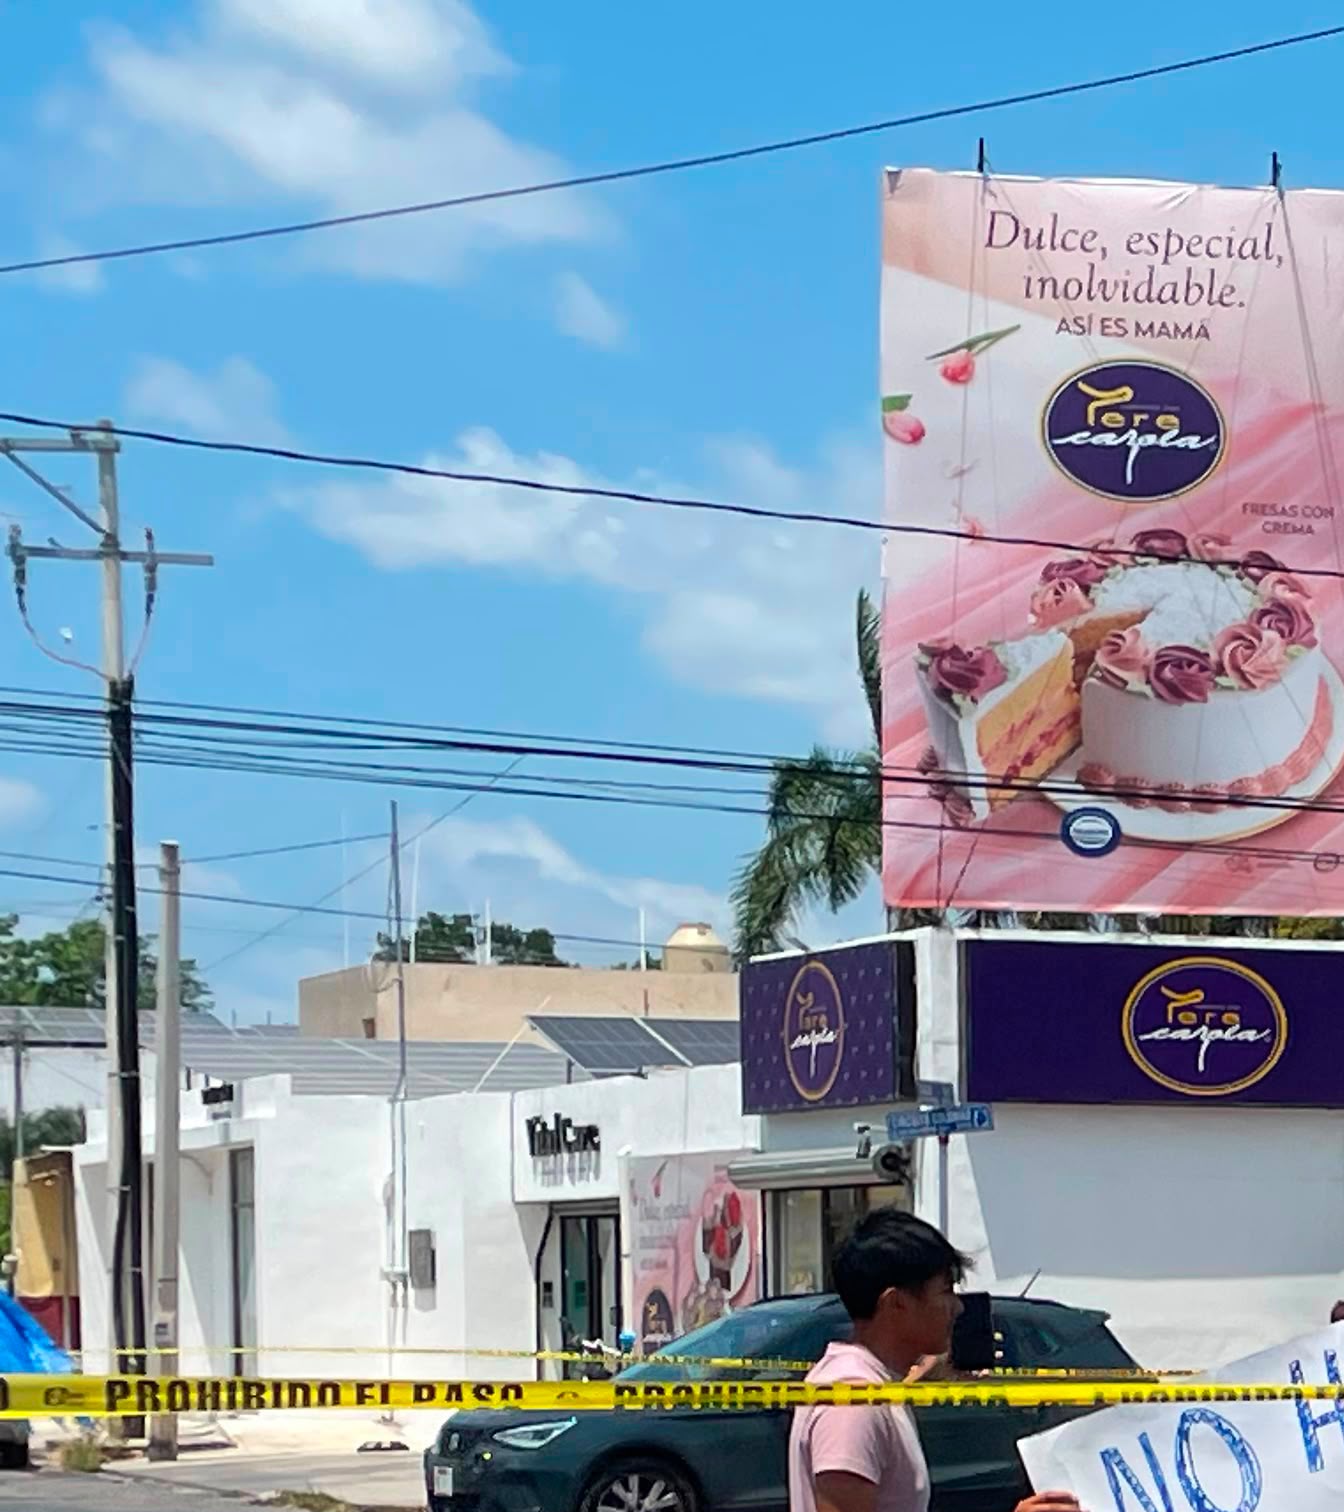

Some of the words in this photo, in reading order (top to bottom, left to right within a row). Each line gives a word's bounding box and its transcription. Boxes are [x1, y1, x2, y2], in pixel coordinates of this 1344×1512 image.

[984, 209, 1108, 261] Dulce,
[1125, 221, 1284, 268] especial,
[1023, 264, 1246, 309] inolvidable.
[1100, 318, 1128, 338] ES
[1241, 502, 1298, 519] FRESAS
[1300, 504, 1335, 520] CON
[1261, 520, 1316, 536] CREMA
[104, 1379, 340, 1412] PROHIBIDO
